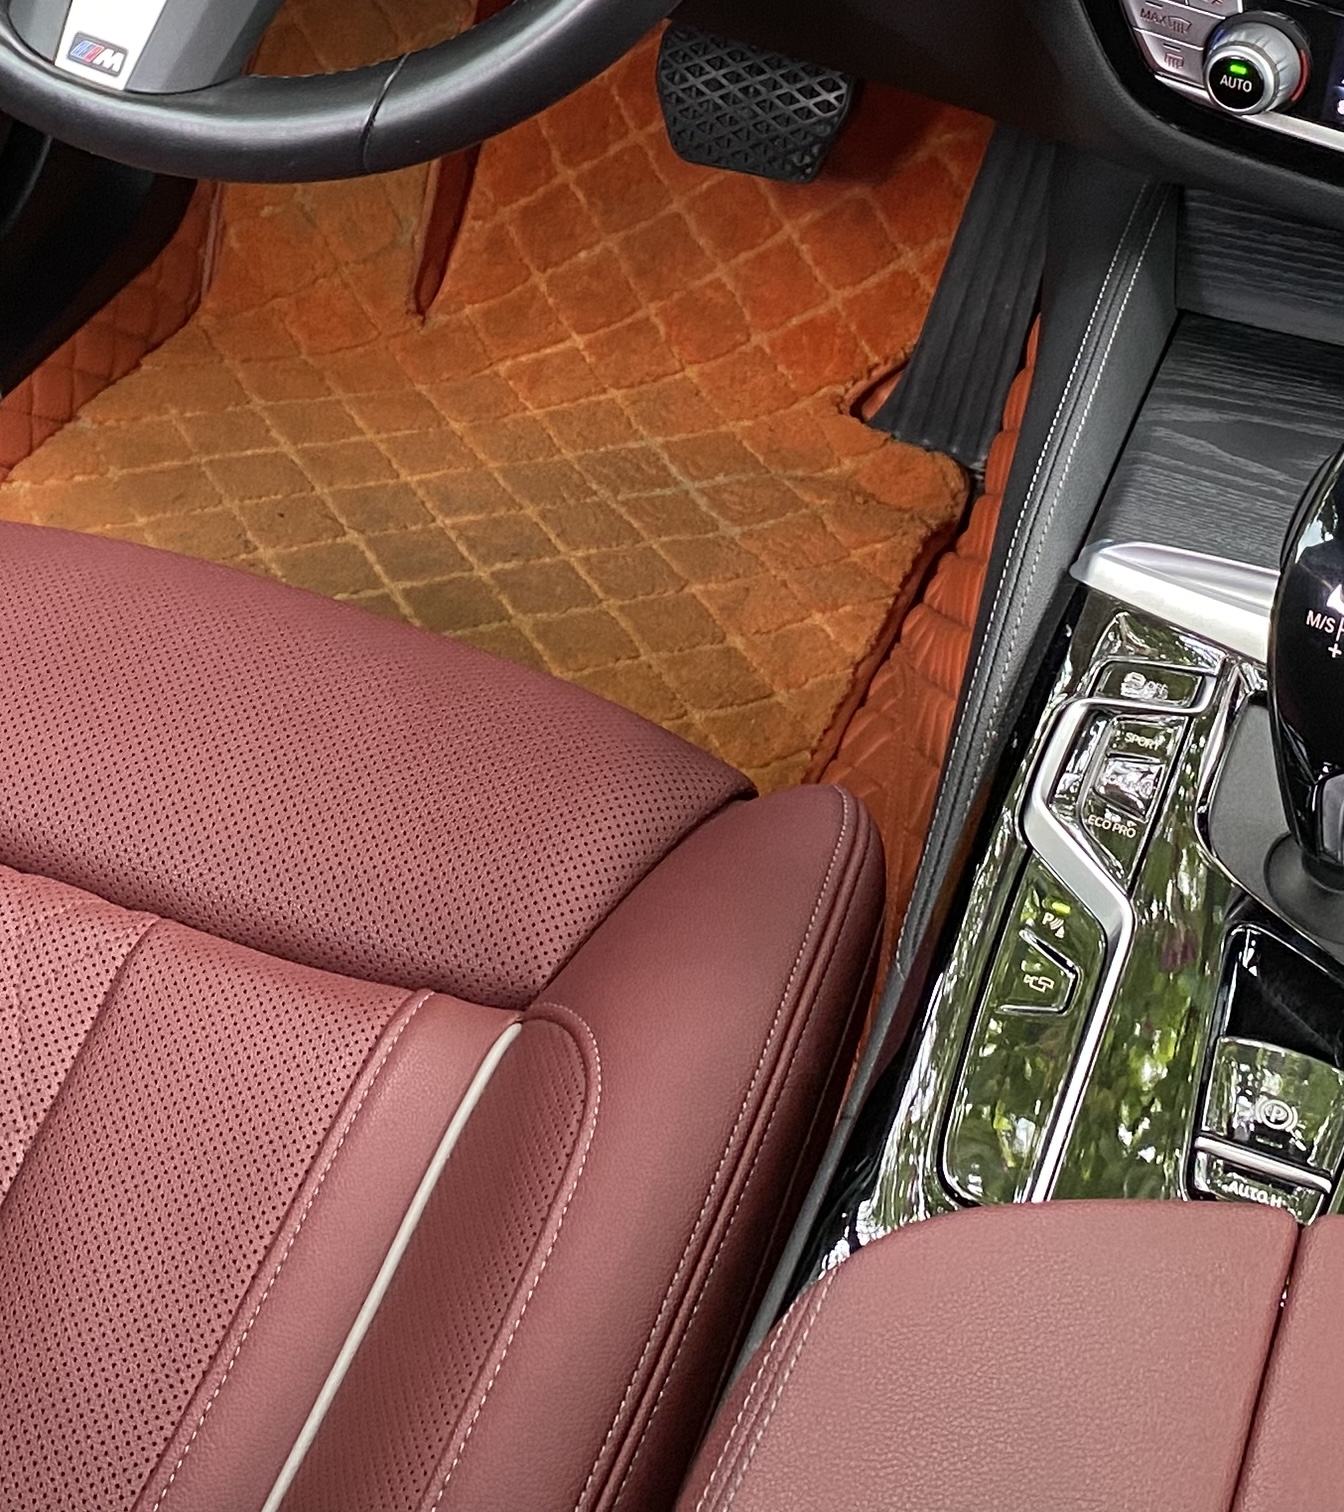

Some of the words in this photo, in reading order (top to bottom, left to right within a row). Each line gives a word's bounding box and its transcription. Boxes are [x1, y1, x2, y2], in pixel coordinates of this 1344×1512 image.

[1140, 7, 1167, 26] MAX
[1219, 74, 1253, 93] AUTO
[1306, 610, 1336, 634] M/S
[1125, 732, 1161, 750] SPORT
[1088, 814, 1111, 830] ECO
[1112, 821, 1137, 838] PRO
[1228, 1180, 1269, 1205] AUTO
